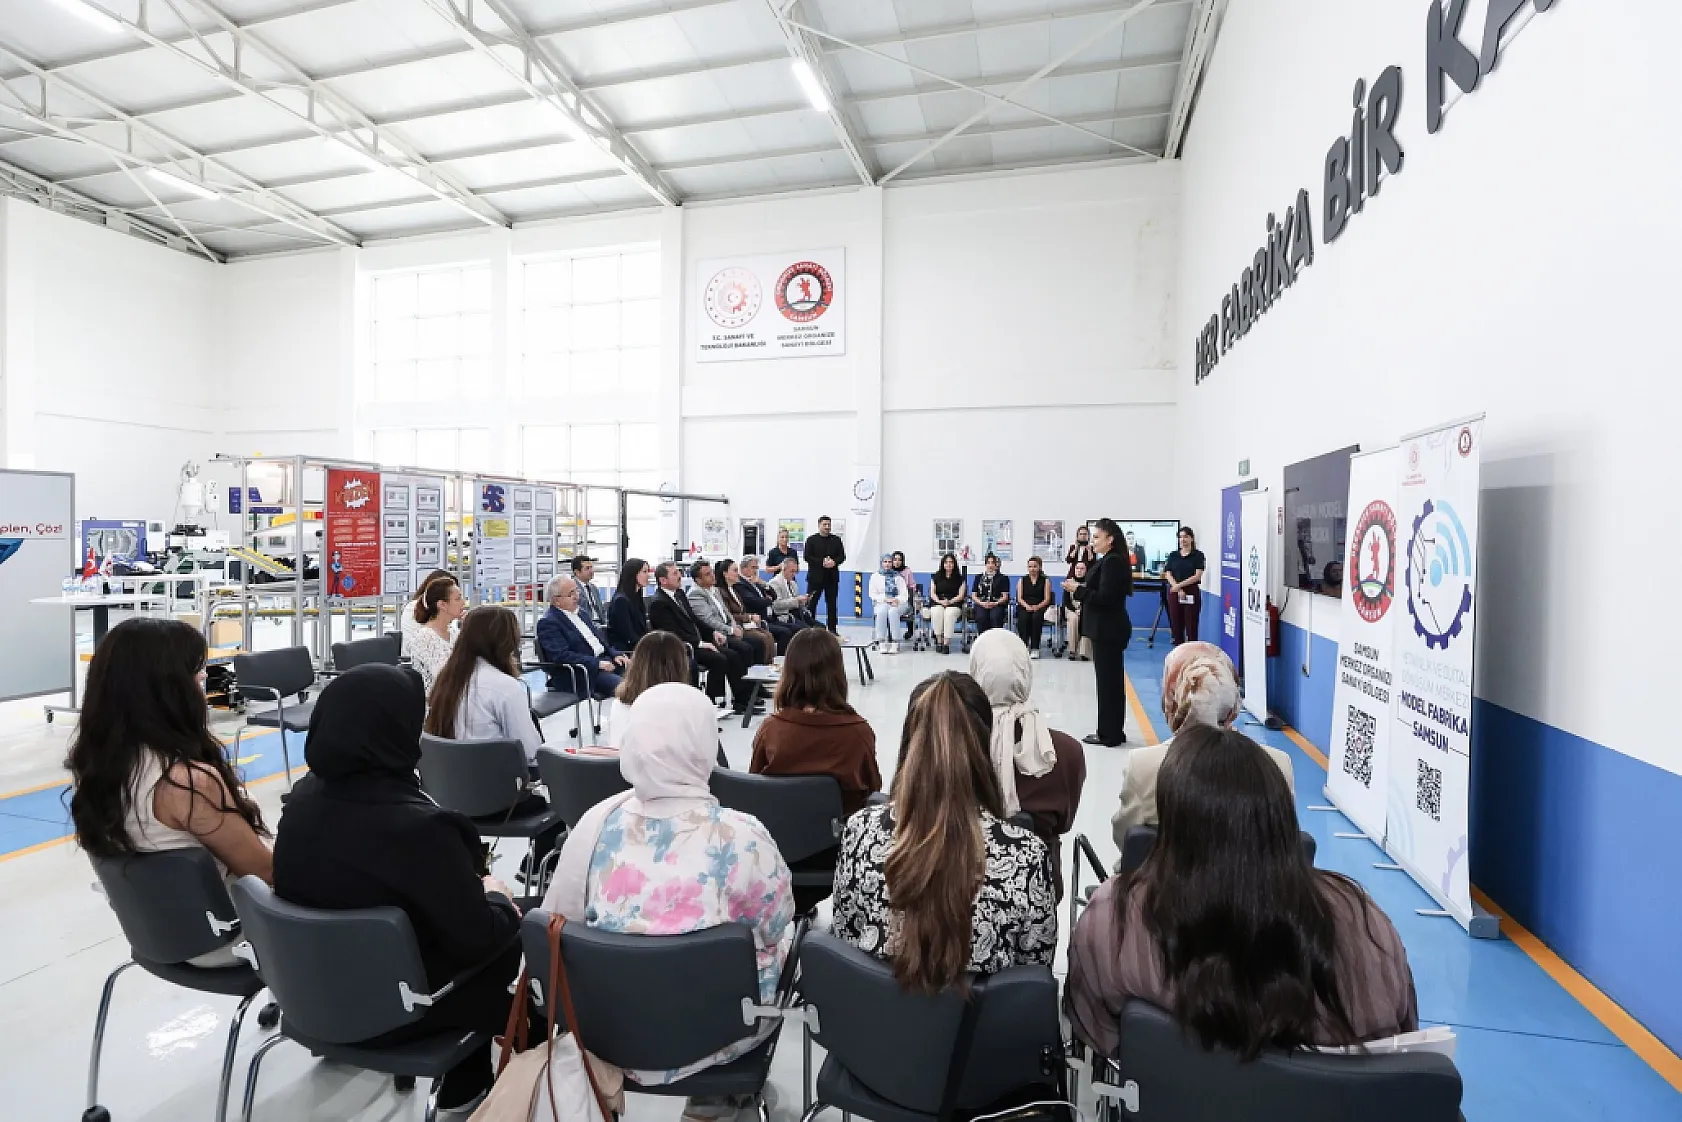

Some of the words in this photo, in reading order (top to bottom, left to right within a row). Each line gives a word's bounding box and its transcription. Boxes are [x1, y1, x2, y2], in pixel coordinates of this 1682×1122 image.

[1195, 313, 1219, 386] HER
[1221, 188, 1314, 356] FABRİKA
[1323, 65, 1404, 244] BİR
[1340, 654, 1362, 674] MERKEZ
[1353, 642, 1379, 661] SAMSUN
[1401, 690, 1428, 717] MODEL
[1428, 702, 1469, 737] FABRİKA
[1413, 720, 1449, 755] SAMSUN
